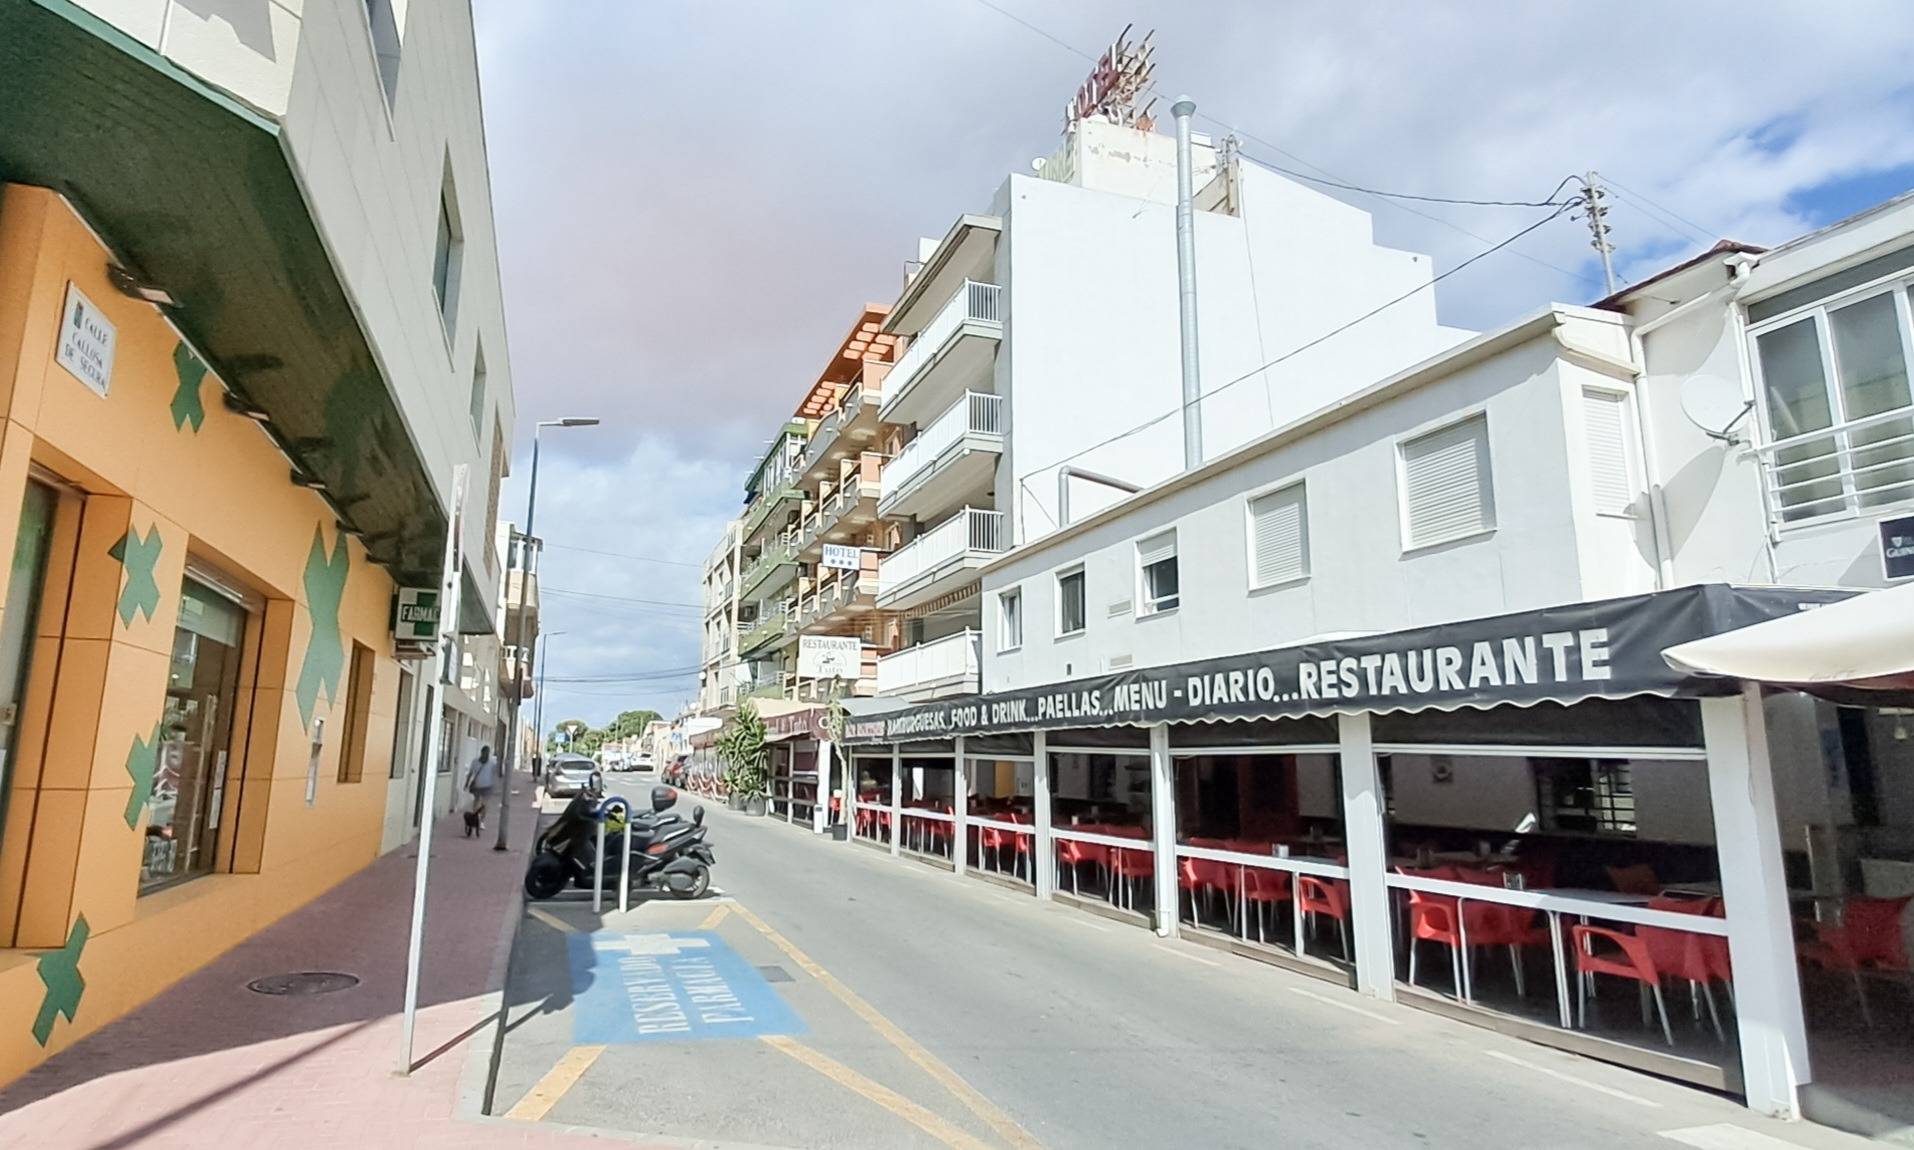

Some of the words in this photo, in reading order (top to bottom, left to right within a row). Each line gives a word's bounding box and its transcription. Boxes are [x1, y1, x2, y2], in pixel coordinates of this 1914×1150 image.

[85, 318, 107, 344] CALLE
[64, 343, 74, 361] DE
[72, 332, 103, 369] CALLOSA
[825, 545, 858, 558] HOTEL
[802, 638, 858, 651] RESTAURANTE
[950, 706, 977, 729] FOOD
[981, 704, 988, 725] &
[1114, 680, 1167, 712] MENU
[1299, 628, 1611, 700] RESTAURANTE
[618, 956, 691, 1034] RESERVADO
